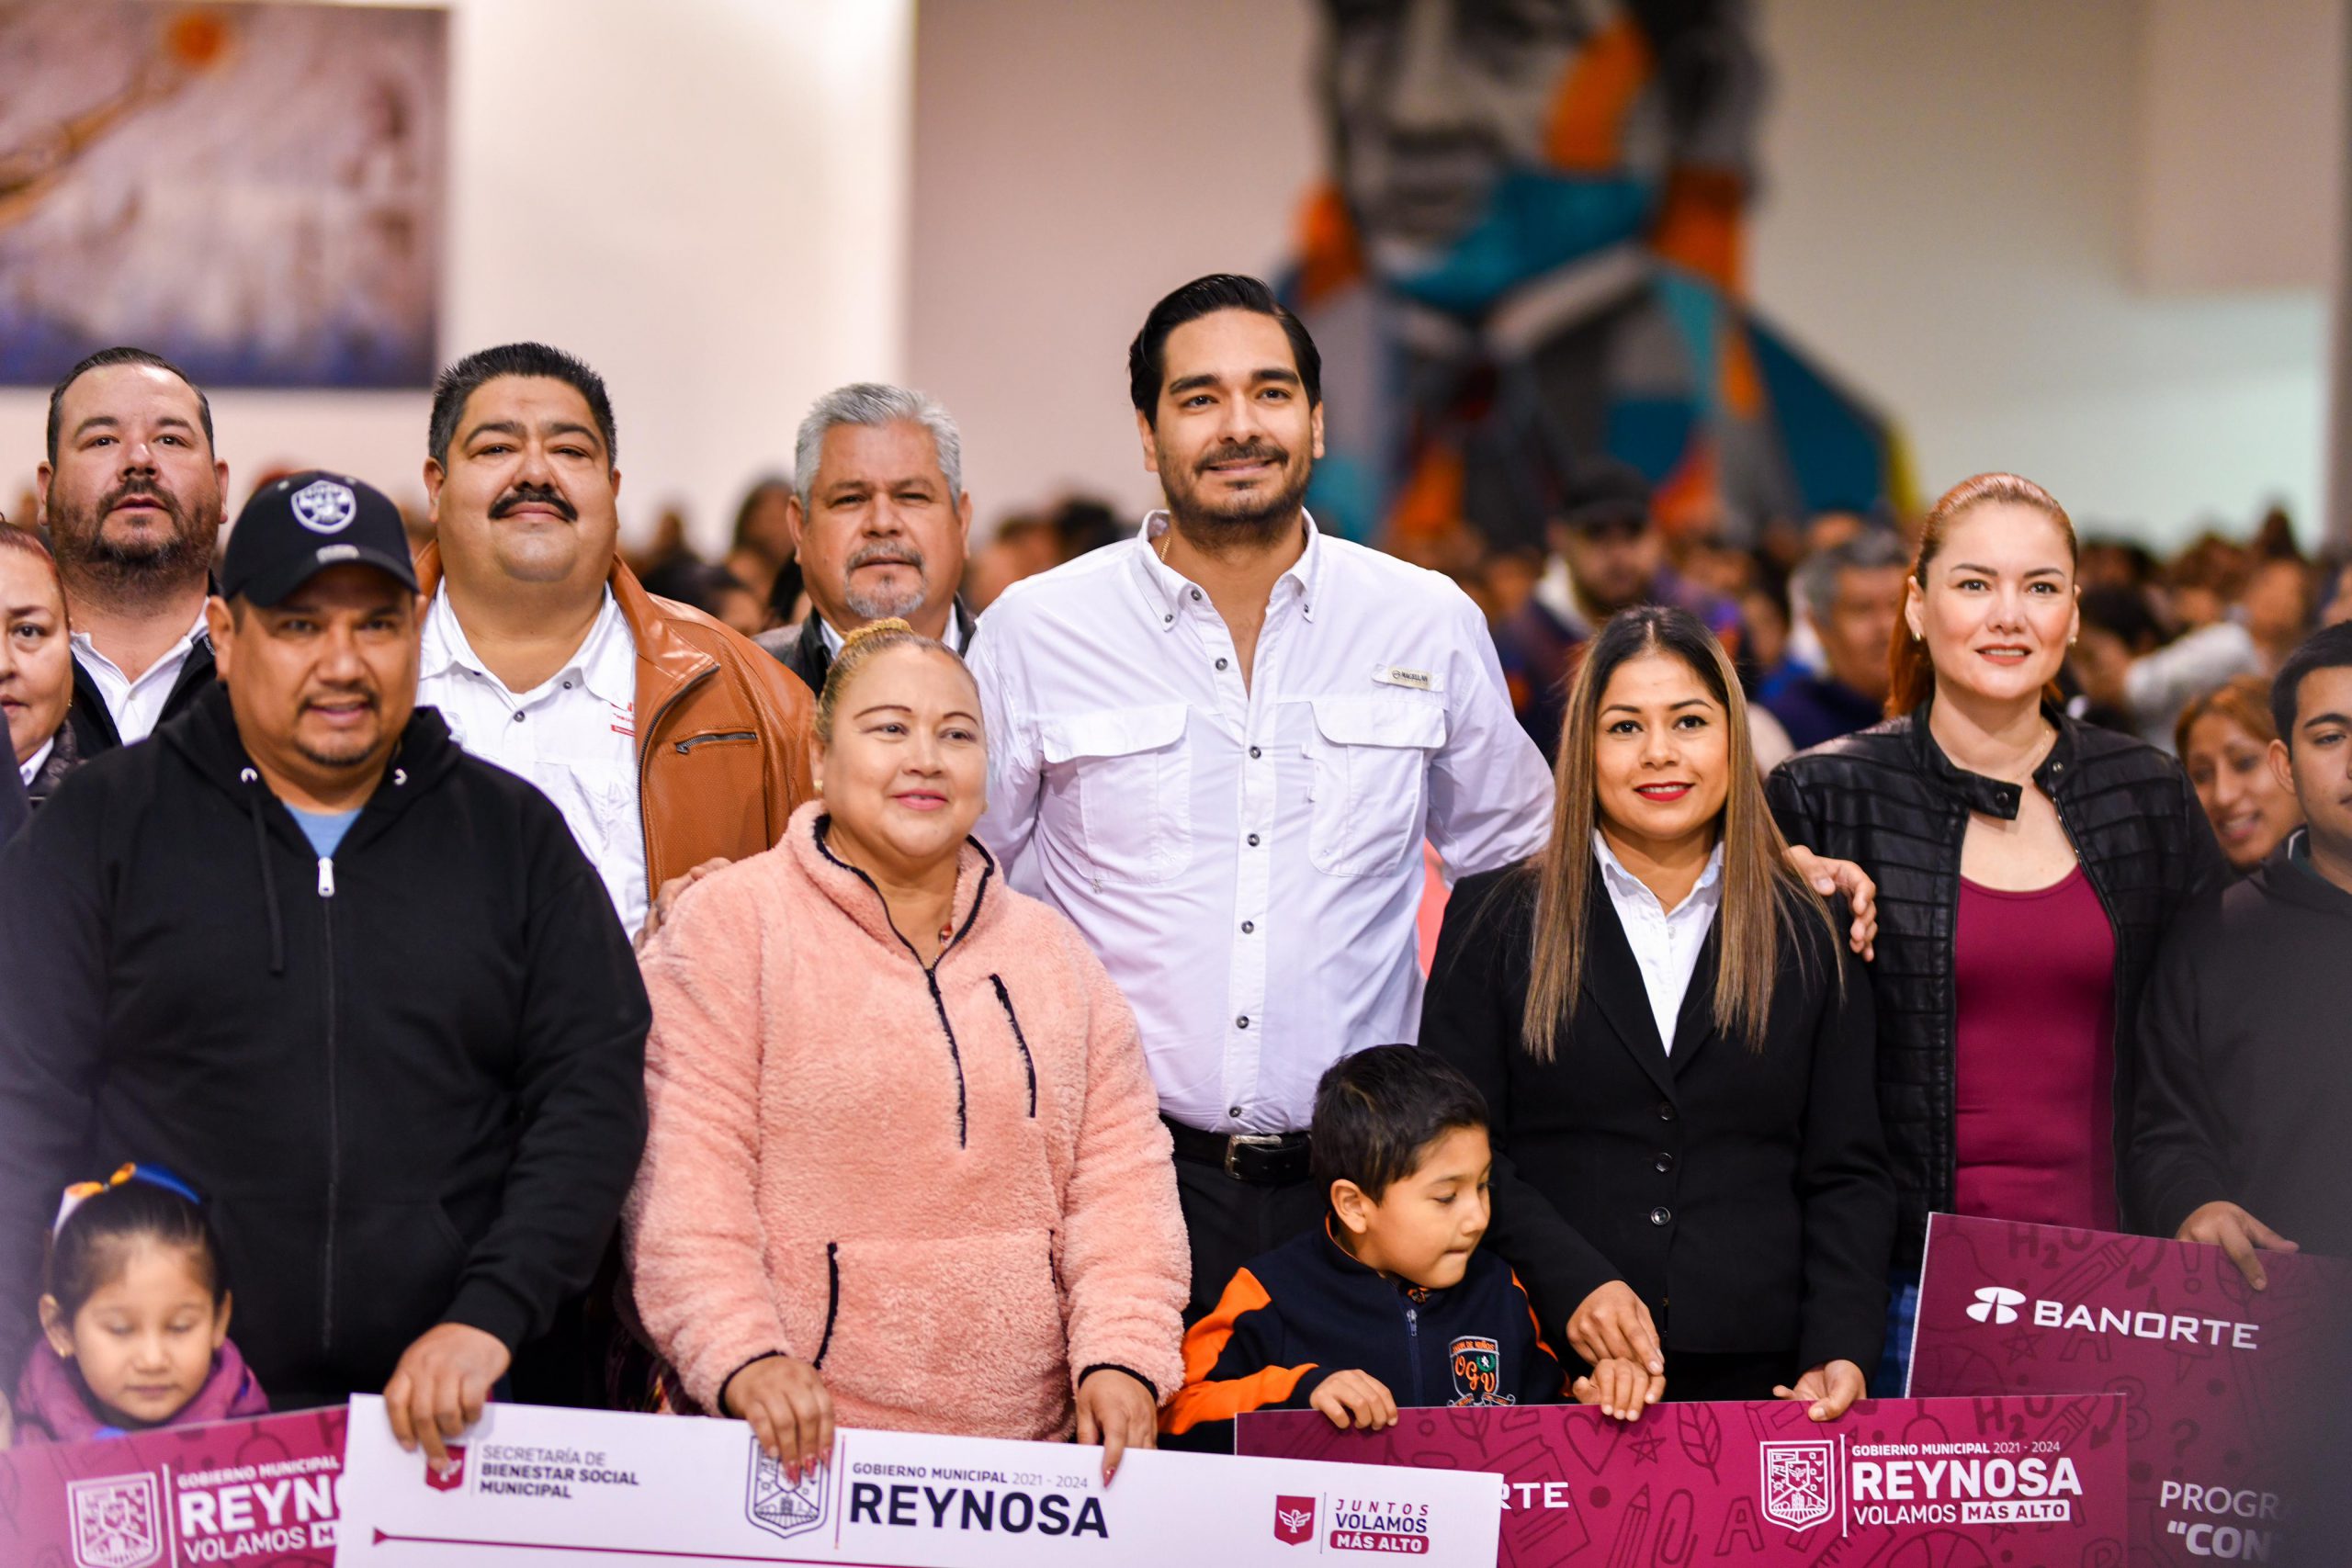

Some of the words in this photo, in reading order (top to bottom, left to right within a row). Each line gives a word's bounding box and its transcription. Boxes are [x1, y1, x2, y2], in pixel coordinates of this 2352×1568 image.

[2033, 1299, 2259, 1349] BANORTE
[482, 1445, 581, 1464] SECRETARÍA
[584, 1451, 605, 1466] DE
[1852, 1444, 1918, 1457] GOBIERNO
[1922, 1442, 1990, 1456] MUNICIPAL
[1993, 1441, 2020, 1454] 2021
[2031, 1441, 2061, 1453] 2024
[177, 1465, 256, 1489] GOBIERNO
[258, 1455, 341, 1479] MUNICIPAL
[481, 1462, 574, 1481] BIENESTAR
[579, 1469, 639, 1485] SOCIAL
[853, 1462, 926, 1478] GOBIERNO
[932, 1468, 1008, 1483] MUNICIPAL
[1012, 1472, 1043, 1486] 2021
[1056, 1475, 1088, 1488] 2024
[1852, 1458, 2083, 1501] REYNOSA
[480, 1480, 571, 1498] MUNICIPAL
[850, 1482, 1109, 1539] REYNOSA
[1336, 1498, 1429, 1517] JUNTOS
[1853, 1504, 1956, 1525] VOLAMOS
[1968, 1501, 2009, 1520] MÁS
[2016, 1504, 2065, 1518] ALTO
[1336, 1513, 1427, 1533] VOLAMOS
[184, 1526, 306, 1563] VOLAMOS
[1337, 1532, 1374, 1549] MÁS
[1378, 1536, 1422, 1552] ALTO
